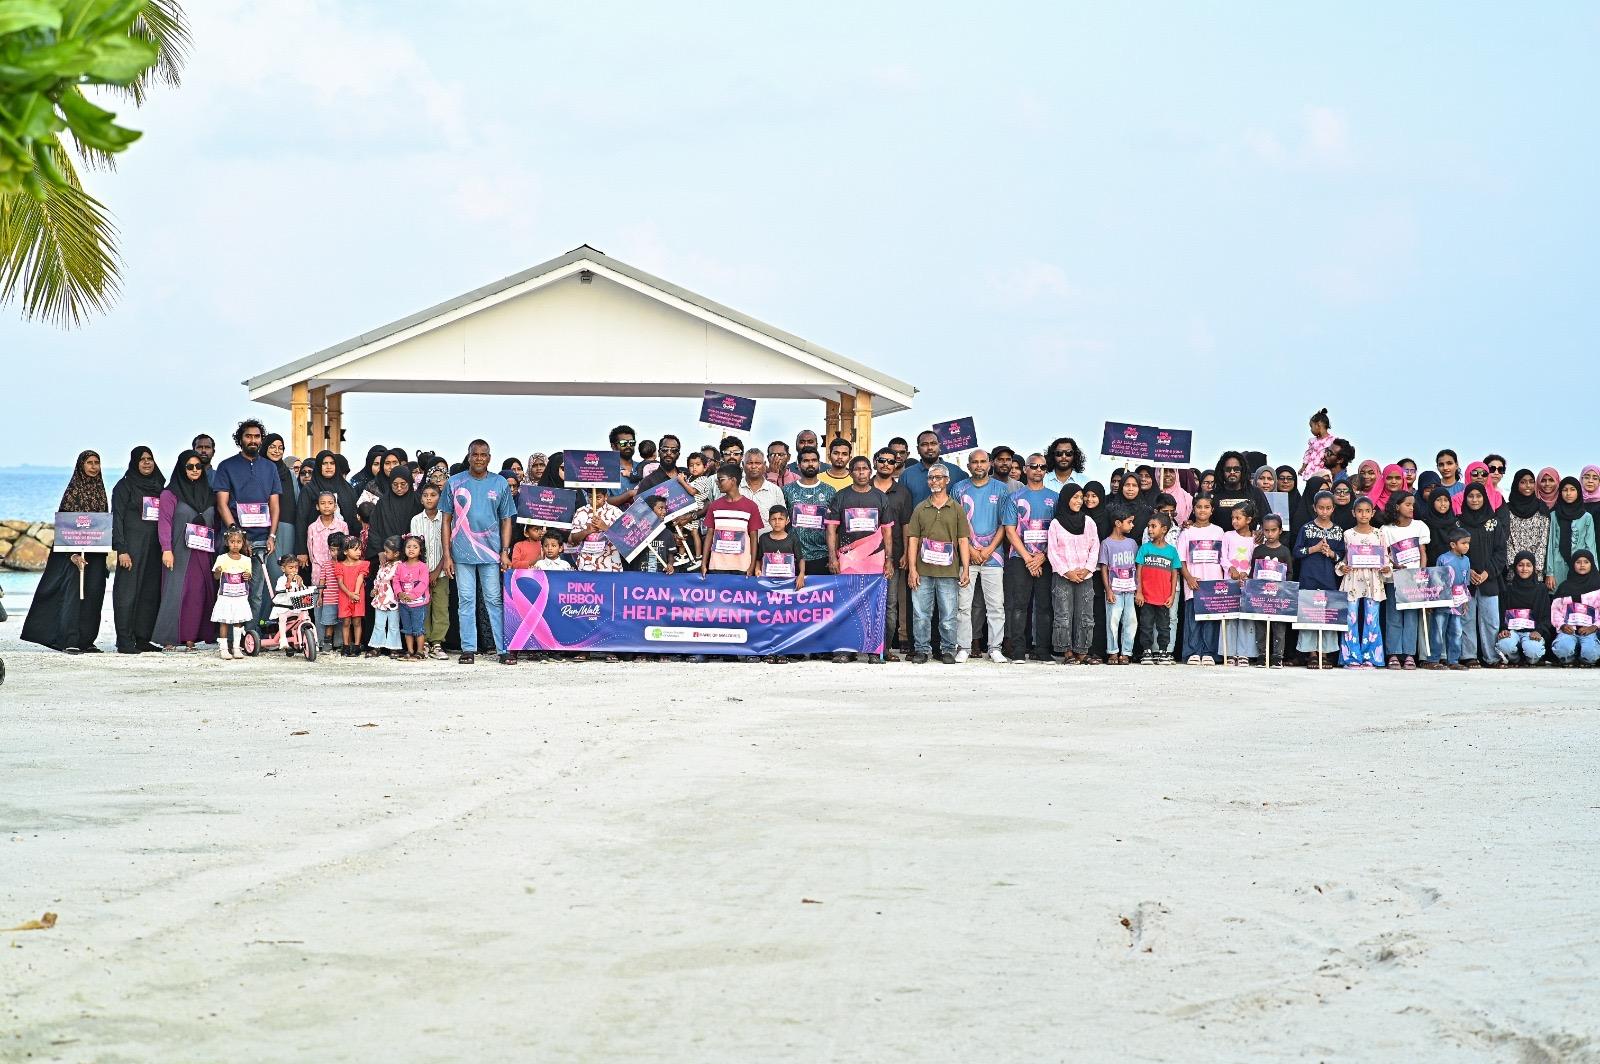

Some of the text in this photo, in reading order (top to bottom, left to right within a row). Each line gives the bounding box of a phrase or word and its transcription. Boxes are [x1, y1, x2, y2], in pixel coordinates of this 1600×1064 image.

[567, 582, 596, 593] PINK
[558, 593, 604, 604] RIBBON
[623, 586, 834, 606] I CAN, YOU CAN, WE CAN
[622, 605, 834, 624] HELP PREVENT CANCER
